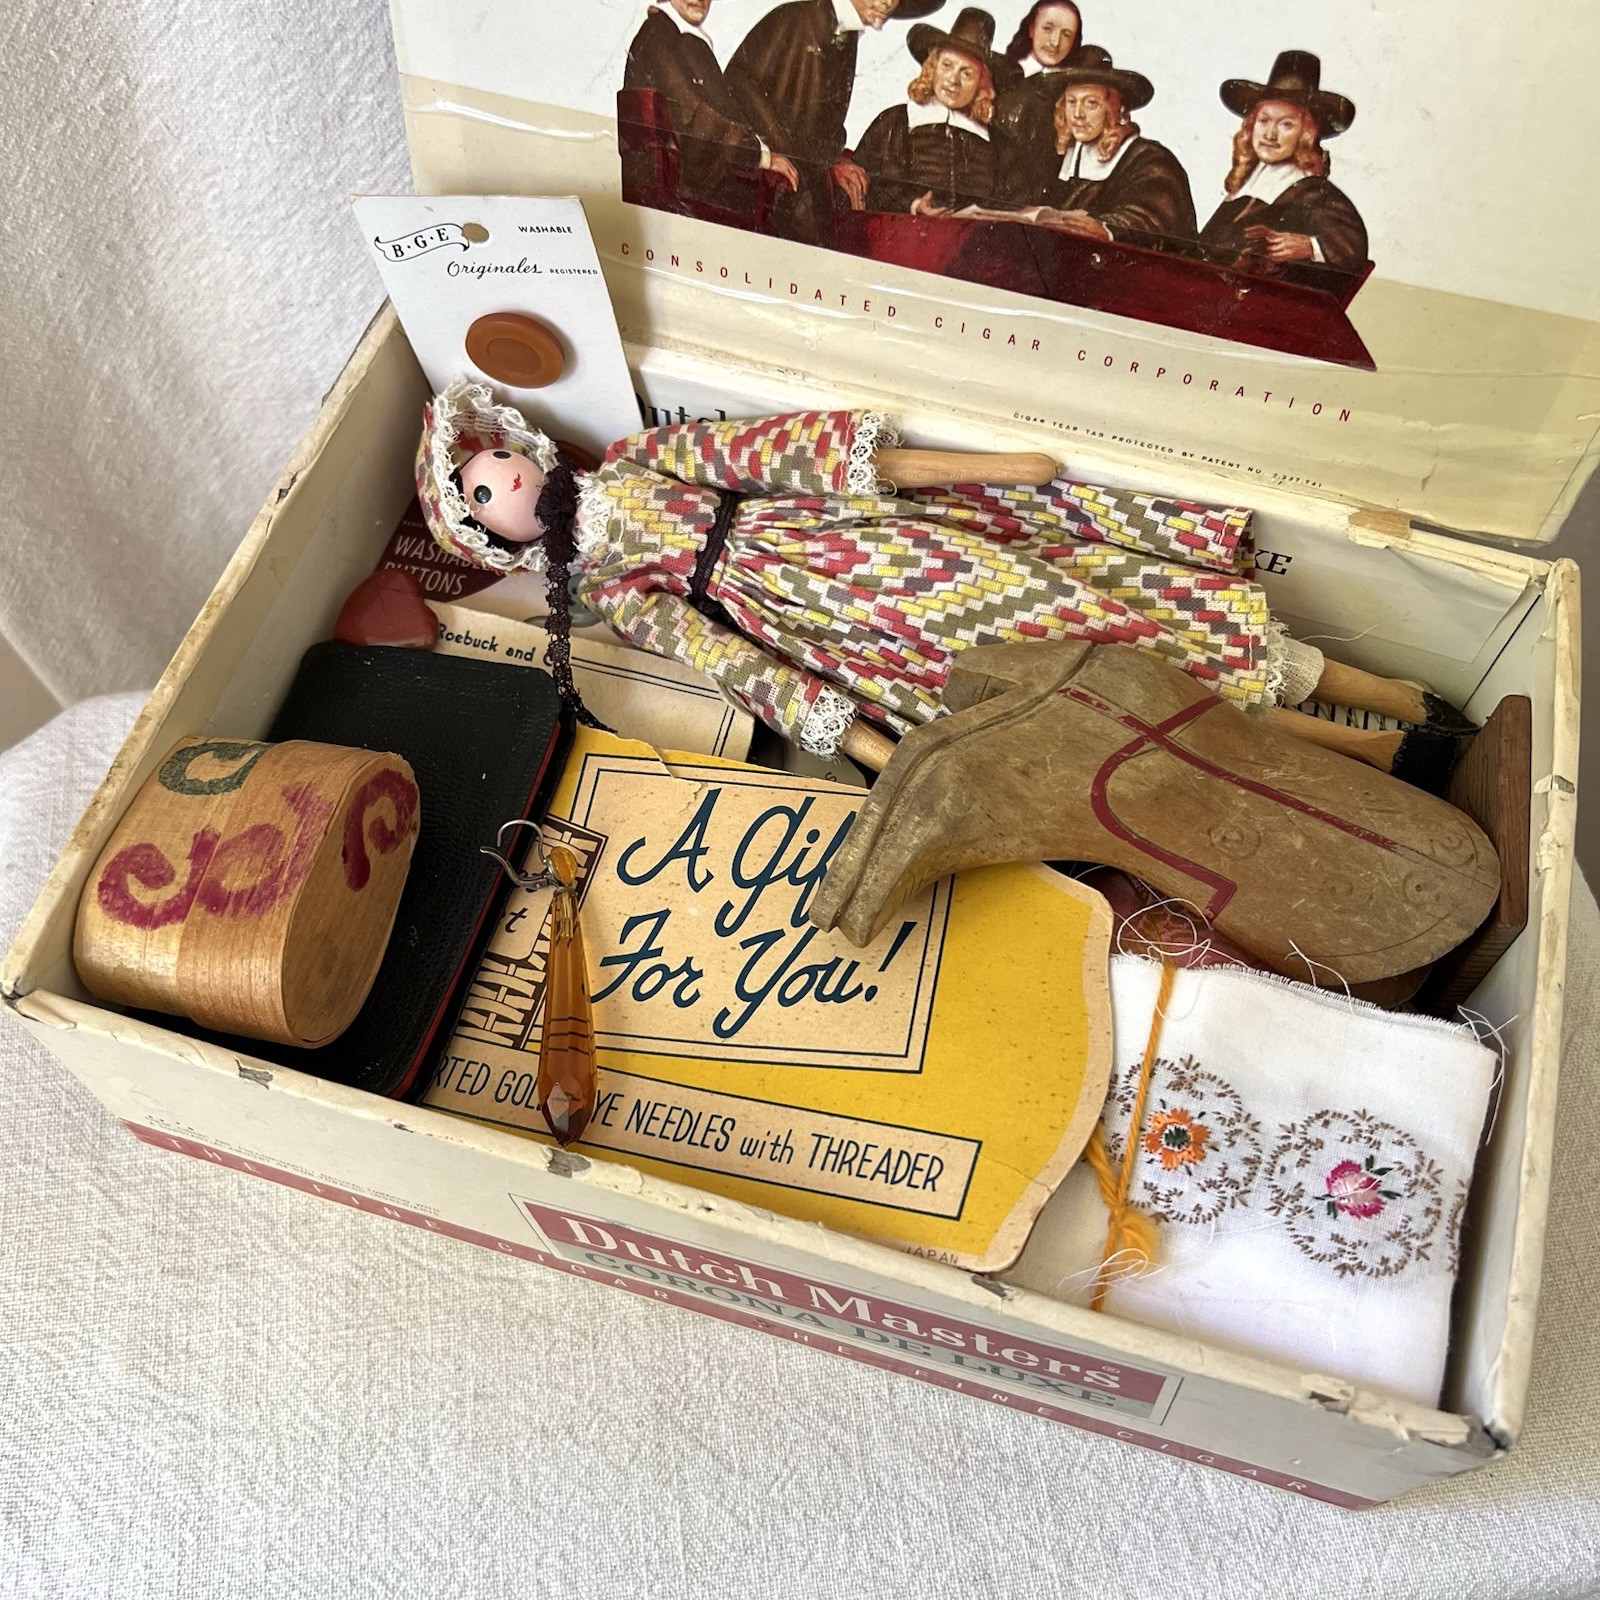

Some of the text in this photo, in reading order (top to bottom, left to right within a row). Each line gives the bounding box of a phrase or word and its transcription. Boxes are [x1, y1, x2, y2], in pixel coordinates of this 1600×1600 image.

[518, 225, 573, 234] WASHABLE
[447, 257, 542, 279] Originales
[621, 243, 1351, 422] CONSOLIDATED CIGAR CORPORATION
[1013, 412, 1045, 424] CIGAR
[1052, 421, 1078, 431] TEAR
[1112, 435, 1174, 454] PROTECTED
[1202, 456, 1240, 469] PATENT
[385, 561, 467, 595] TTONS
[395, 535, 490, 571] WASHA
[438, 623, 499, 652] Roebuck
[505, 647, 536, 662] and
[616, 787, 858, 938] A Gif
[589, 908, 918, 1039] For You!
[435, 1056, 945, 1193] RTED GOL YE NEEDLES with THREADER
[498, 1241, 670, 1300] CIGAR
[560, 1216, 789, 1301] Dutch
[901, 1246, 959, 1264] JAPAN
[584, 1252, 1116, 1407] CORONA DE LUXE
[914, 1368, 1054, 1415] FINE
[1116, 1429, 1307, 1491] CIGAR
